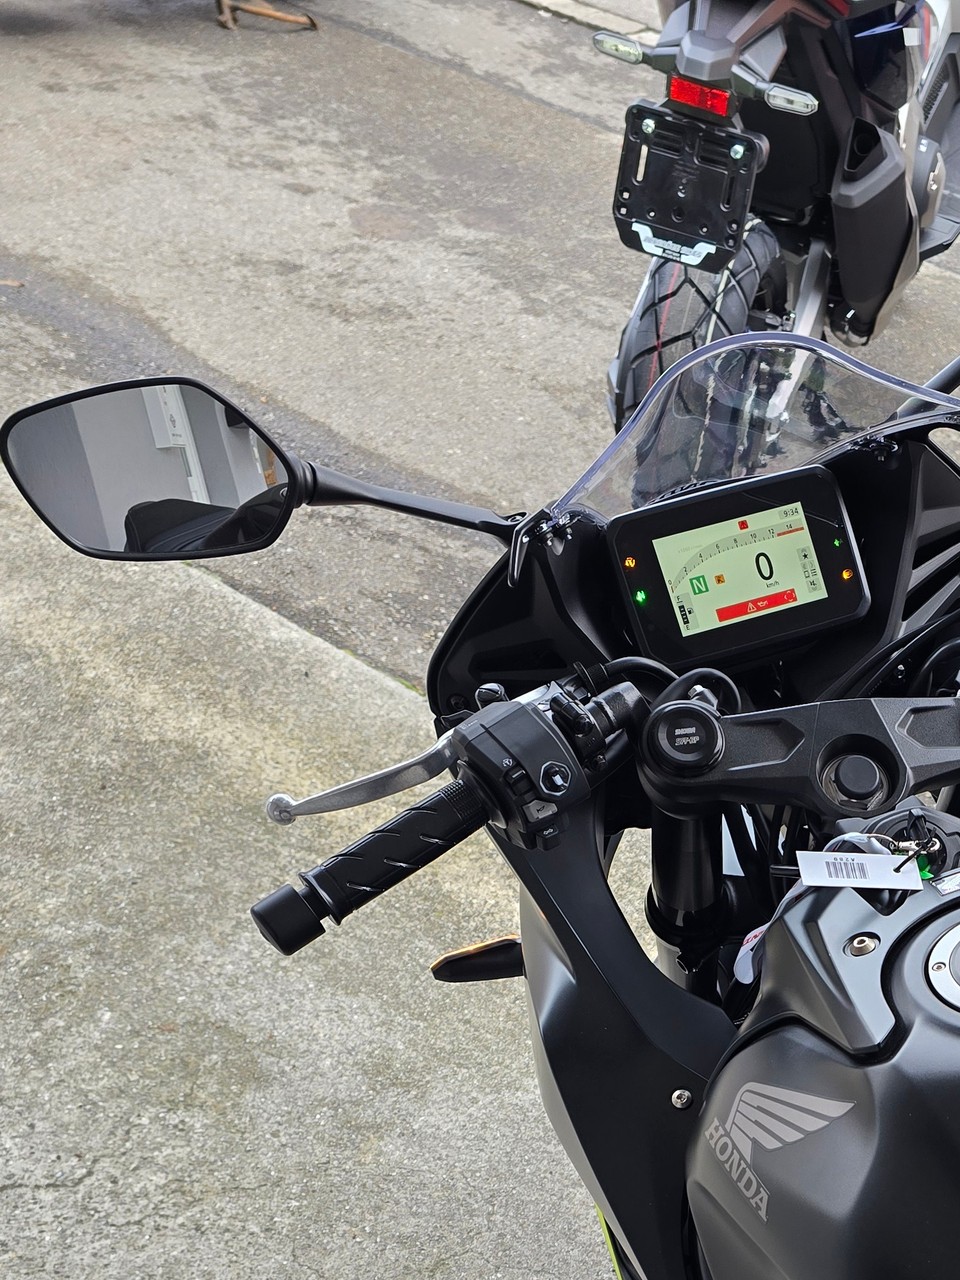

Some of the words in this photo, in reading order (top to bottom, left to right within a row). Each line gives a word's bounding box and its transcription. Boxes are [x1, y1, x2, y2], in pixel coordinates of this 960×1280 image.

[783, 507, 799, 518] 9:34
[750, 532, 757, 540] 10
[755, 551, 774, 581] 0
[692, 577, 706, 594] N
[766, 580, 780, 589] km/h
[704, 1117, 770, 1223] HONDA
